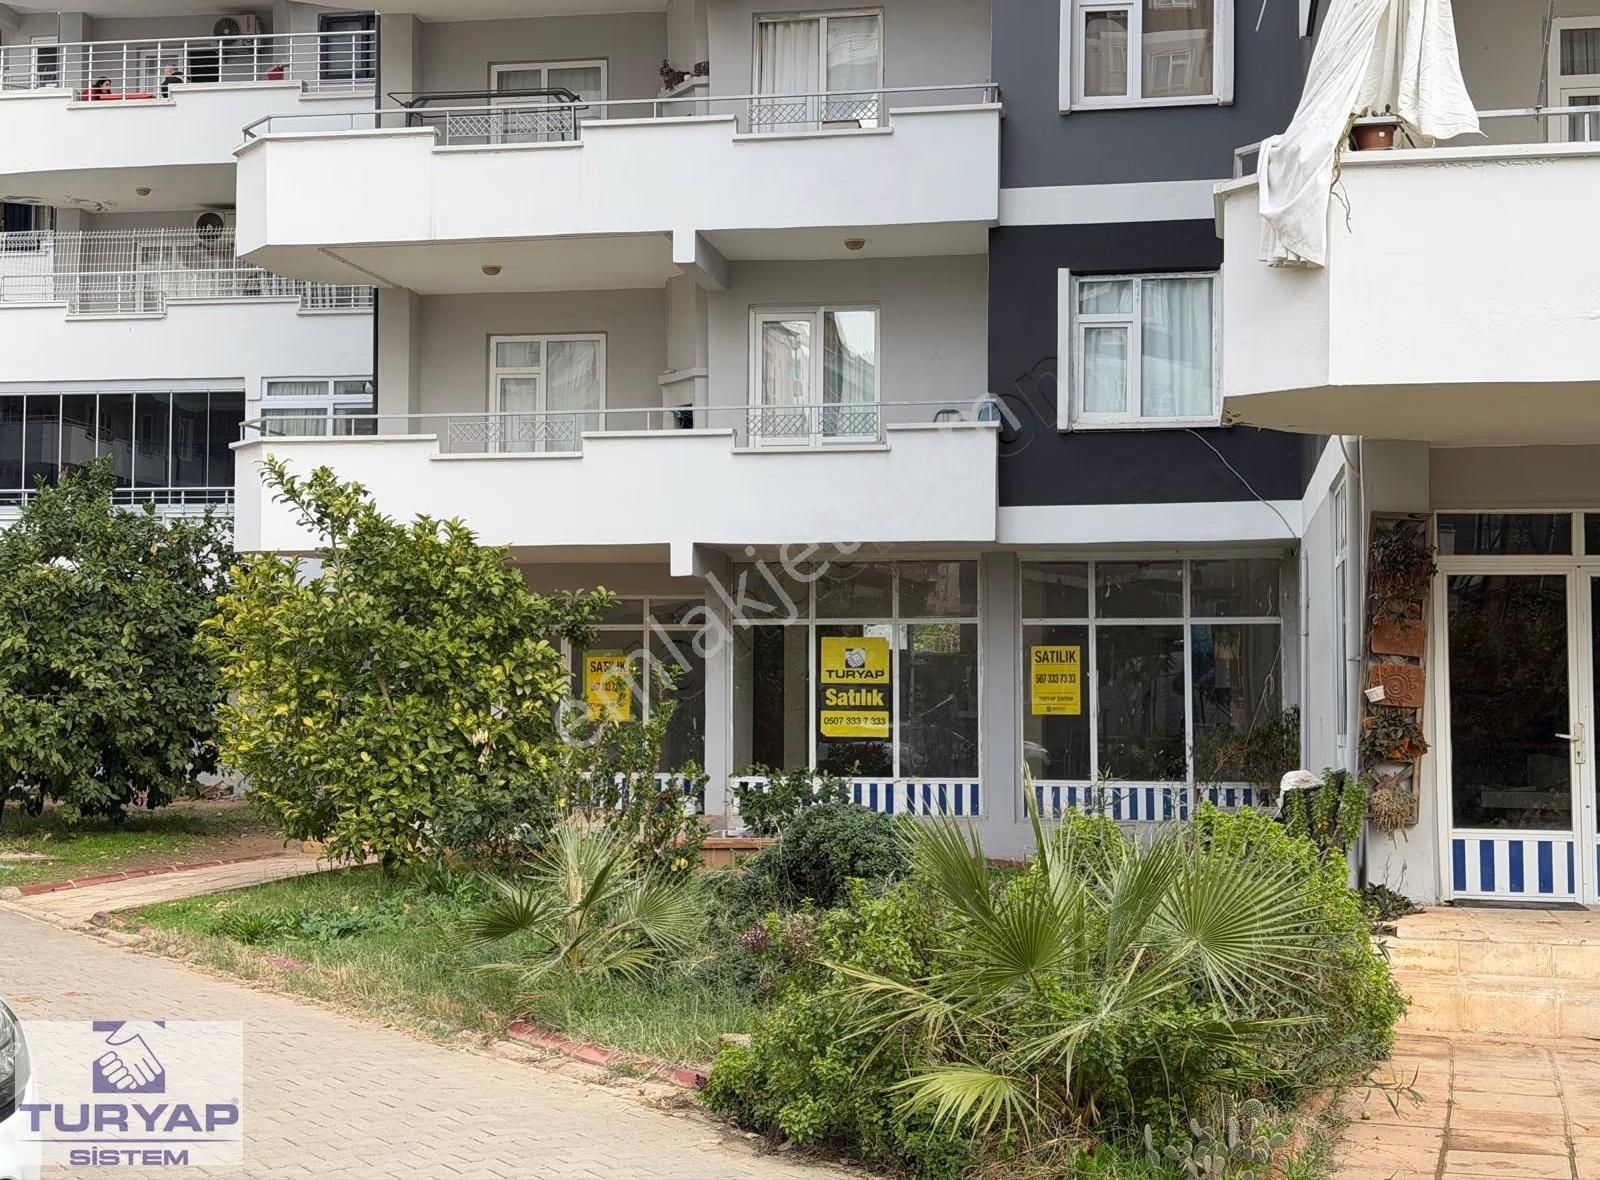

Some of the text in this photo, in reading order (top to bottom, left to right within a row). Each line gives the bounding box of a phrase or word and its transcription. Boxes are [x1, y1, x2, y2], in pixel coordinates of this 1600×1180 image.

[1034, 650, 1076, 663] SATILIK
[825, 669, 885, 679] TURYAP
[1047, 673, 1059, 684] 333
[825, 687, 884, 706] Satılık
[823, 717, 886, 725] 0507 333 7 333
